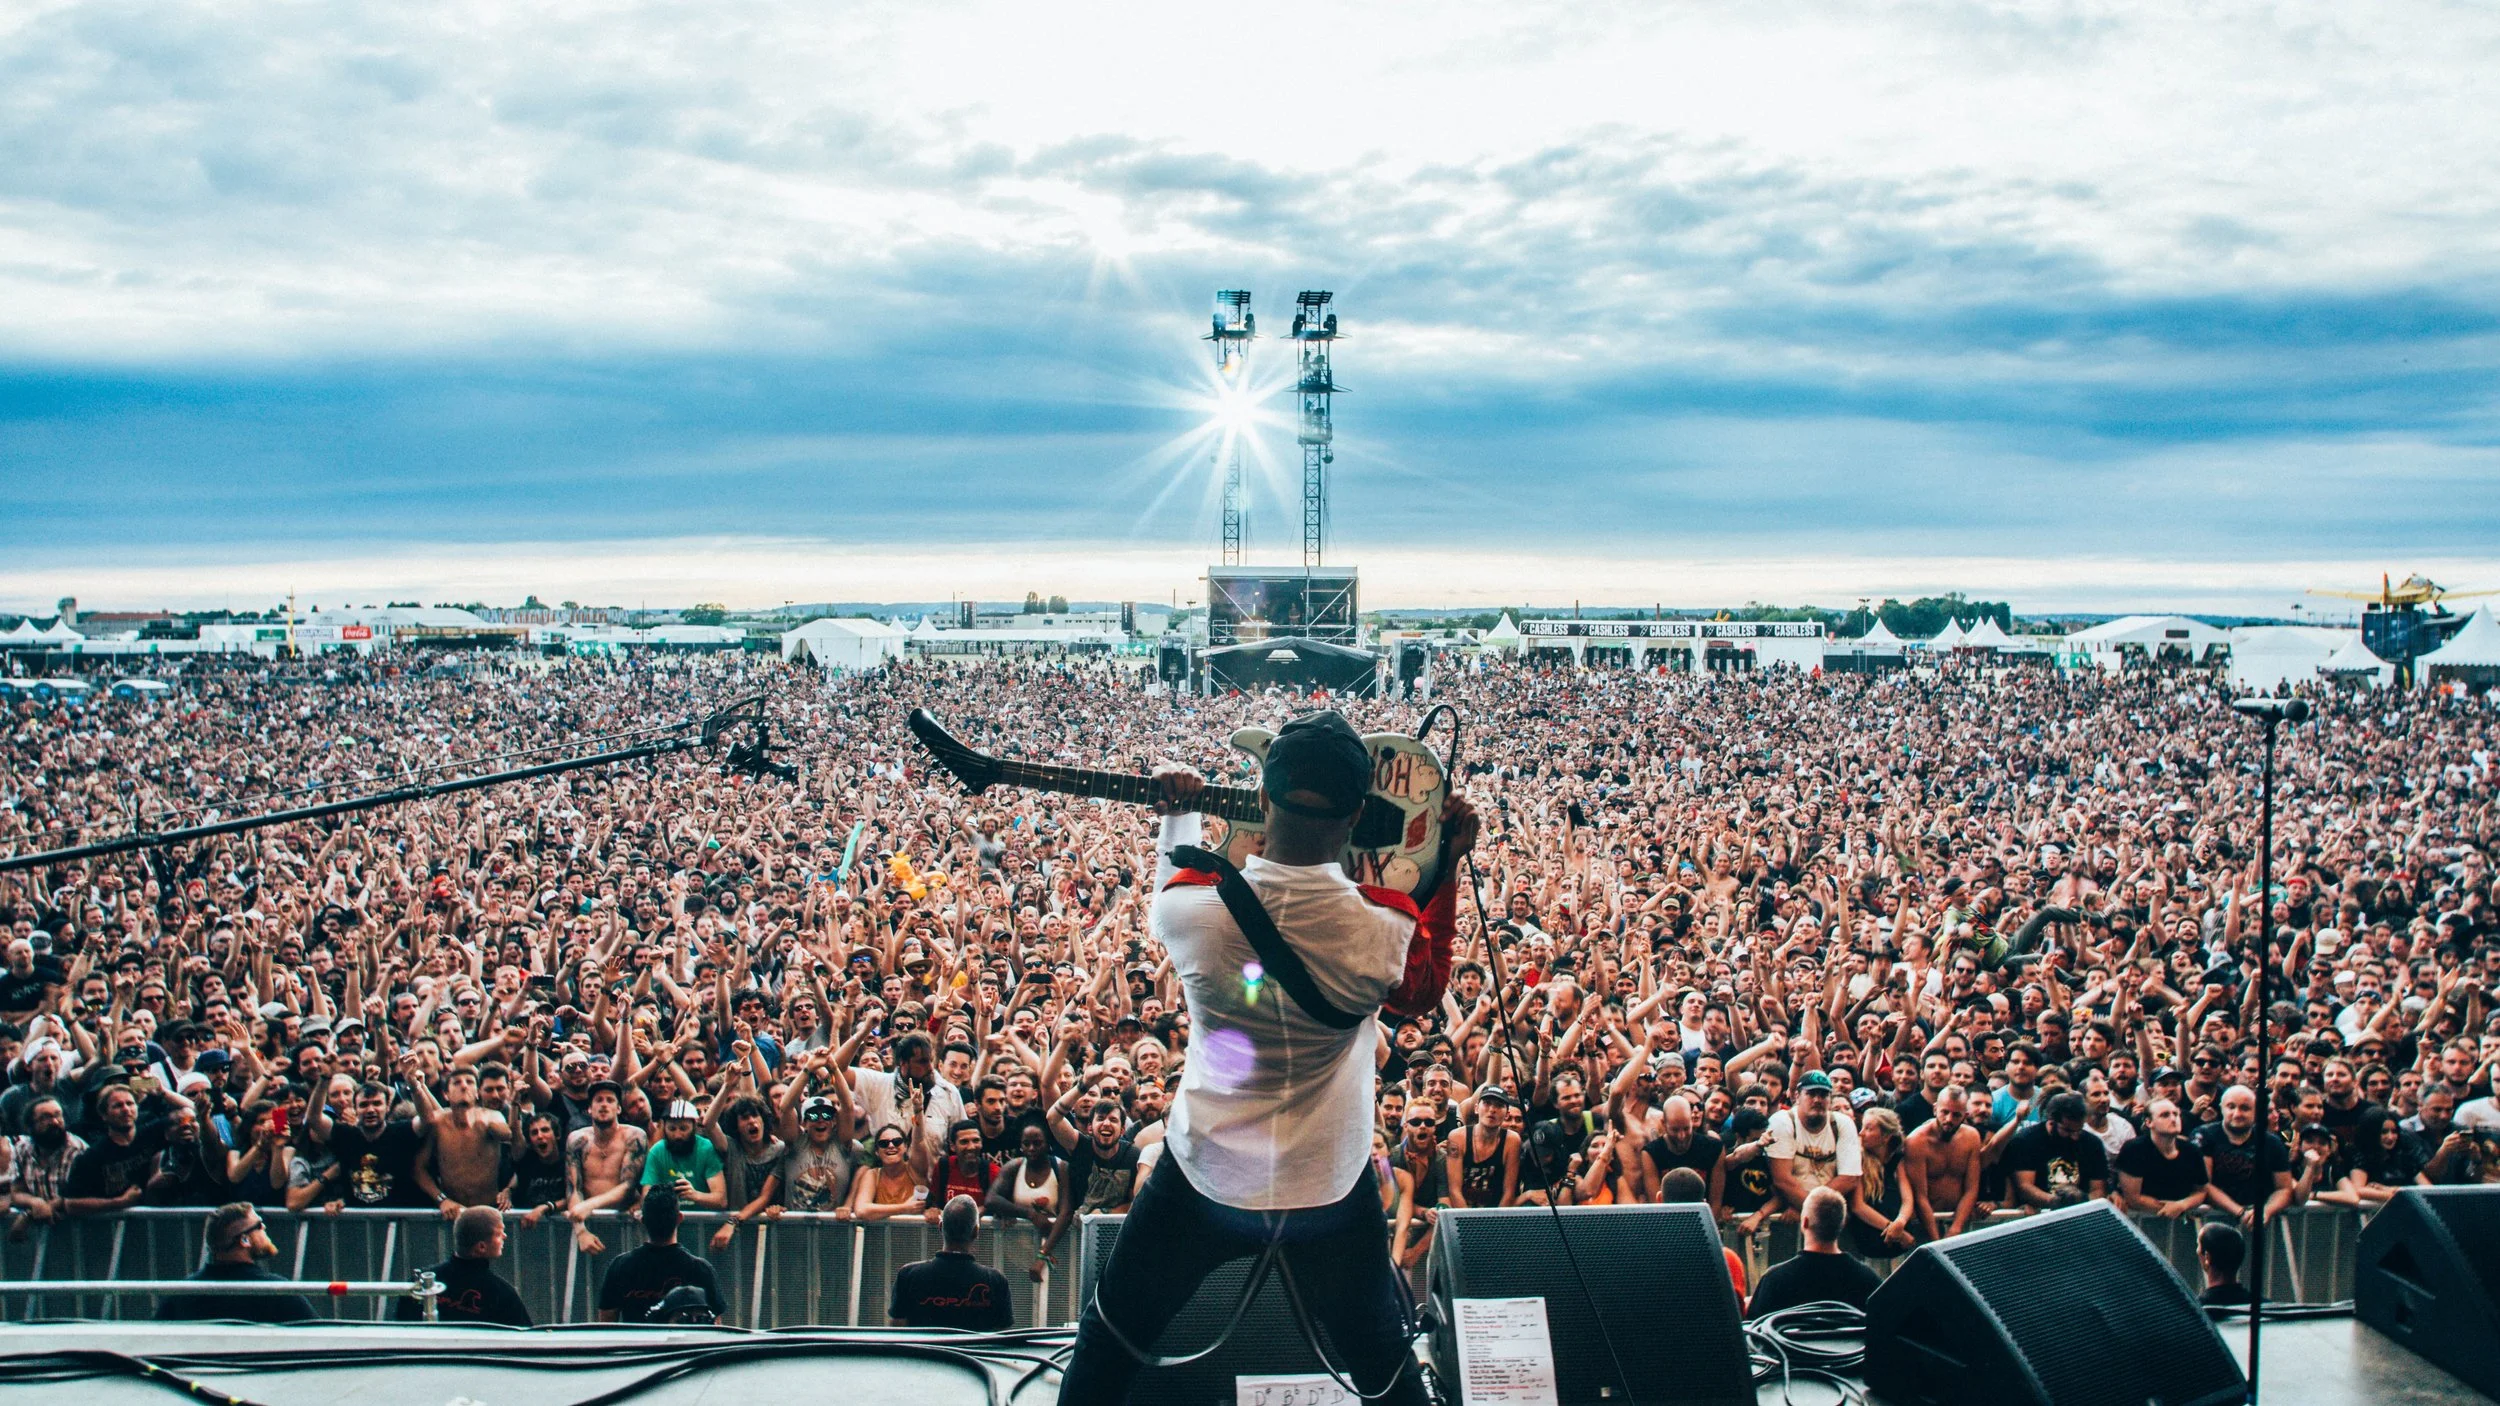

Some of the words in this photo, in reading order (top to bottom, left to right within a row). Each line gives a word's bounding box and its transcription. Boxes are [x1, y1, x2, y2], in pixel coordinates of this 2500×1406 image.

[1528, 623, 1569, 636] CASHLESS
[1588, 624, 1630, 637] CASHLESS
[1649, 624, 1691, 638] CASHLESS
[1715, 624, 1757, 638] CASHLESS
[1774, 624, 1816, 637] CASHLESS
